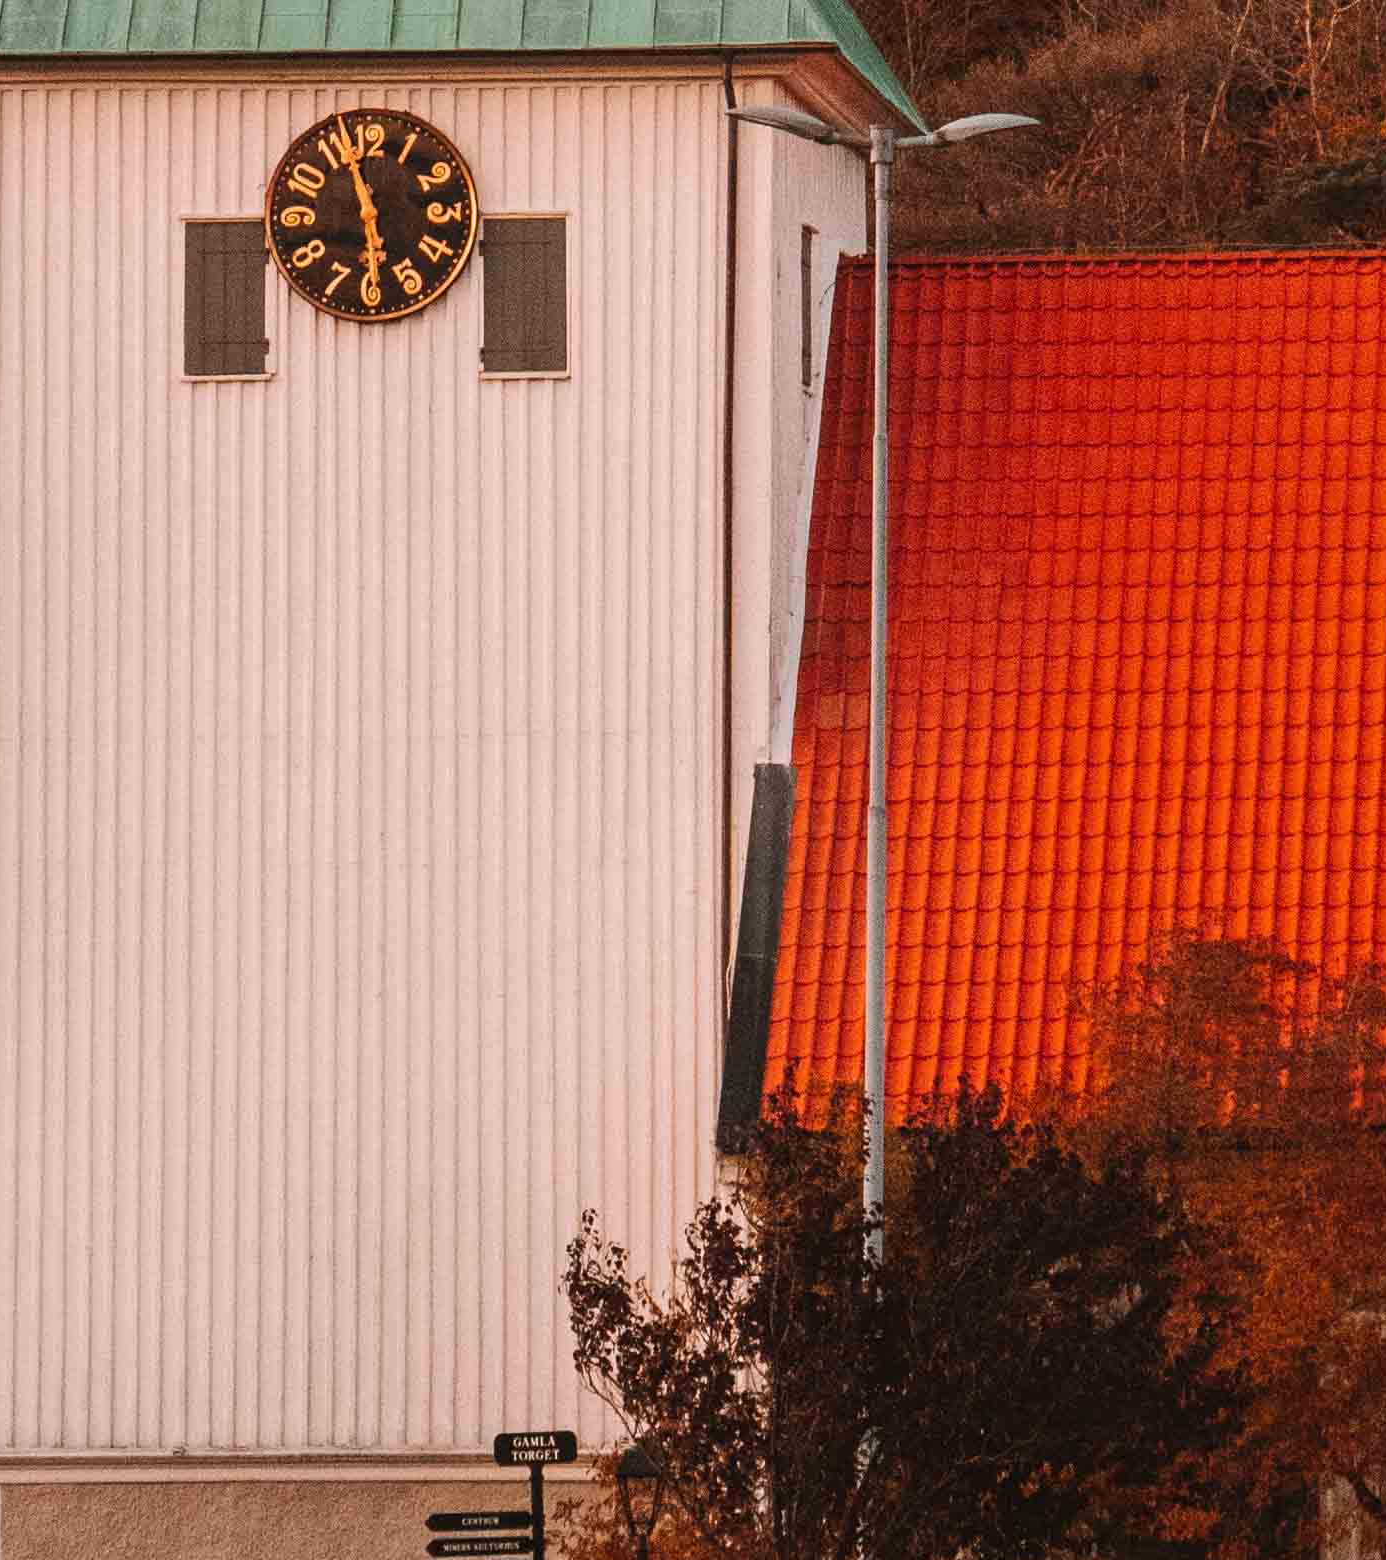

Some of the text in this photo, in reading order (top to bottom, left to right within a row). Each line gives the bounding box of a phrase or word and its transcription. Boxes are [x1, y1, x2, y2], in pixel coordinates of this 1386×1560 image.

[354, 123, 386, 158] 12
[397, 133, 418, 165] 1
[287, 162, 326, 199] 10
[416, 161, 452, 192] 2
[280, 205, 316, 228] 9
[426, 201, 463, 224] 3
[292, 239, 326, 269] 8
[418, 234, 454, 264] 4
[324, 261, 351, 297] 7
[360, 272, 382, 307] 6
[391, 257, 422, 296] 5
[511, 1449, 560, 1462] TORGET
[513, 1435, 556, 1448] GAMLA
